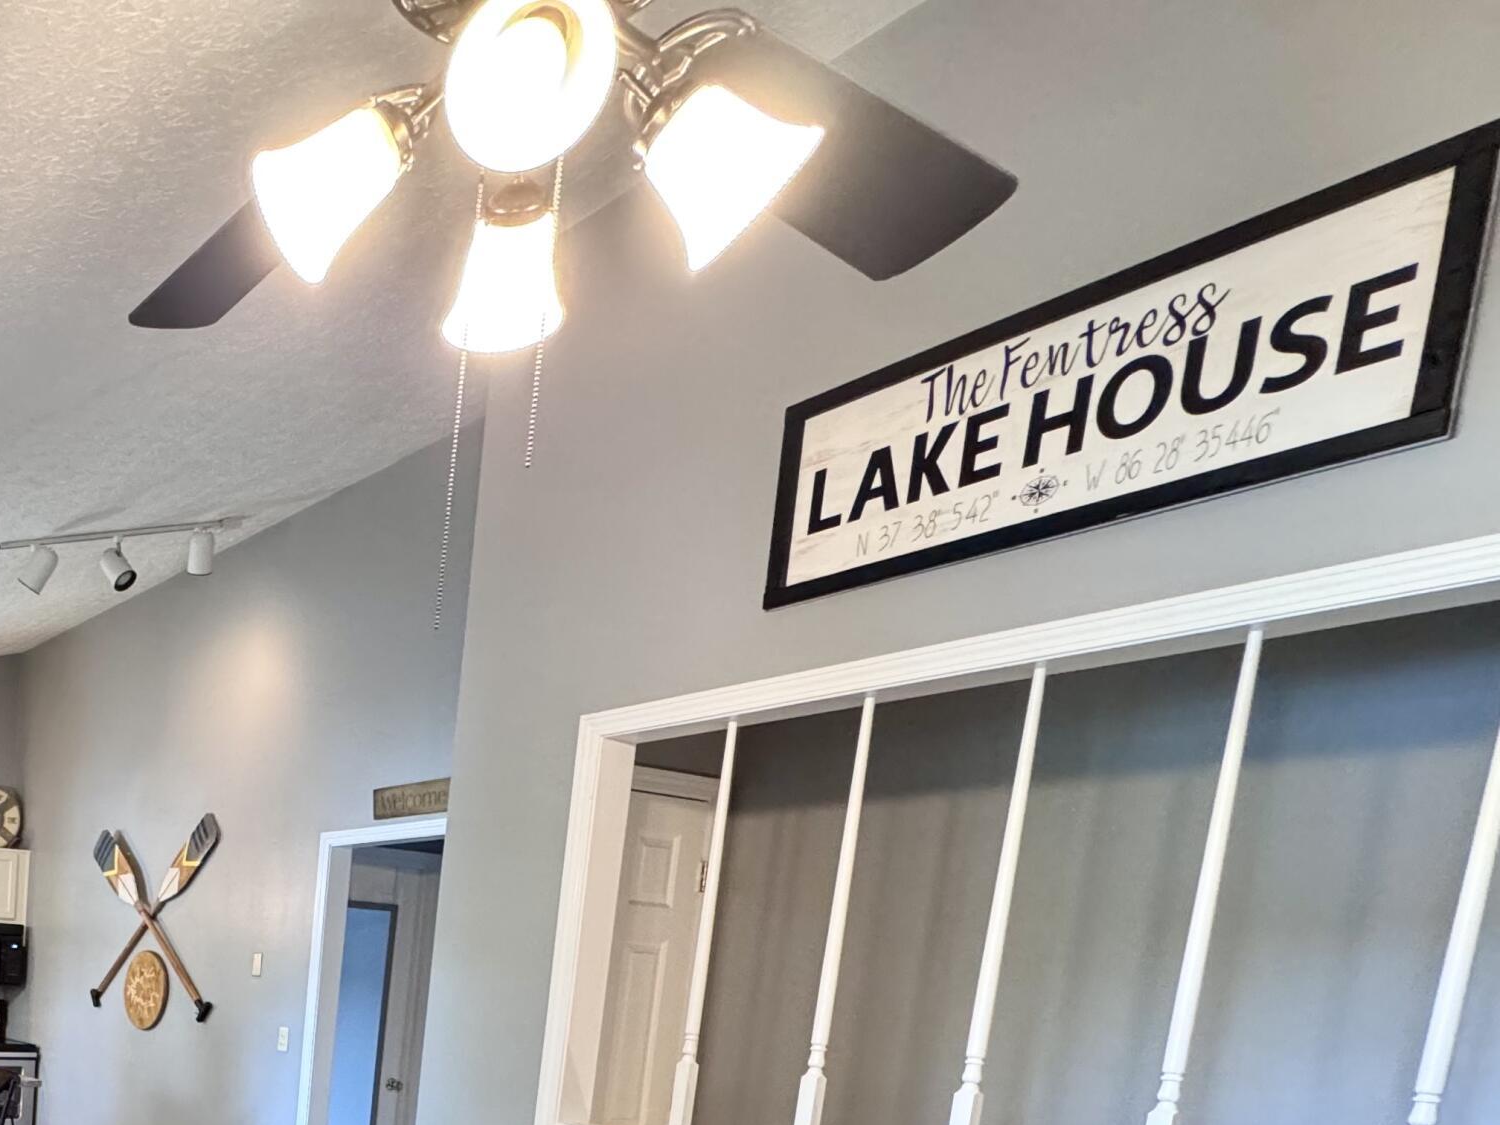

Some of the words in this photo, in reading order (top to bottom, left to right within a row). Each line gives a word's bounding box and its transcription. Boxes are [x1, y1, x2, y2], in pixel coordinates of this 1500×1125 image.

[806, 402, 1009, 535] LAKE
[1021, 262, 1419, 469] HOUSE
[921, 364, 996, 424] The
[1000, 282, 1232, 400] Fentress
[856, 528, 870, 558] N
[877, 520, 902, 553] 37
[1085, 458, 1107, 492] W
[1114, 449, 1143, 485] 86
[380, 788, 447, 812] Welcome
